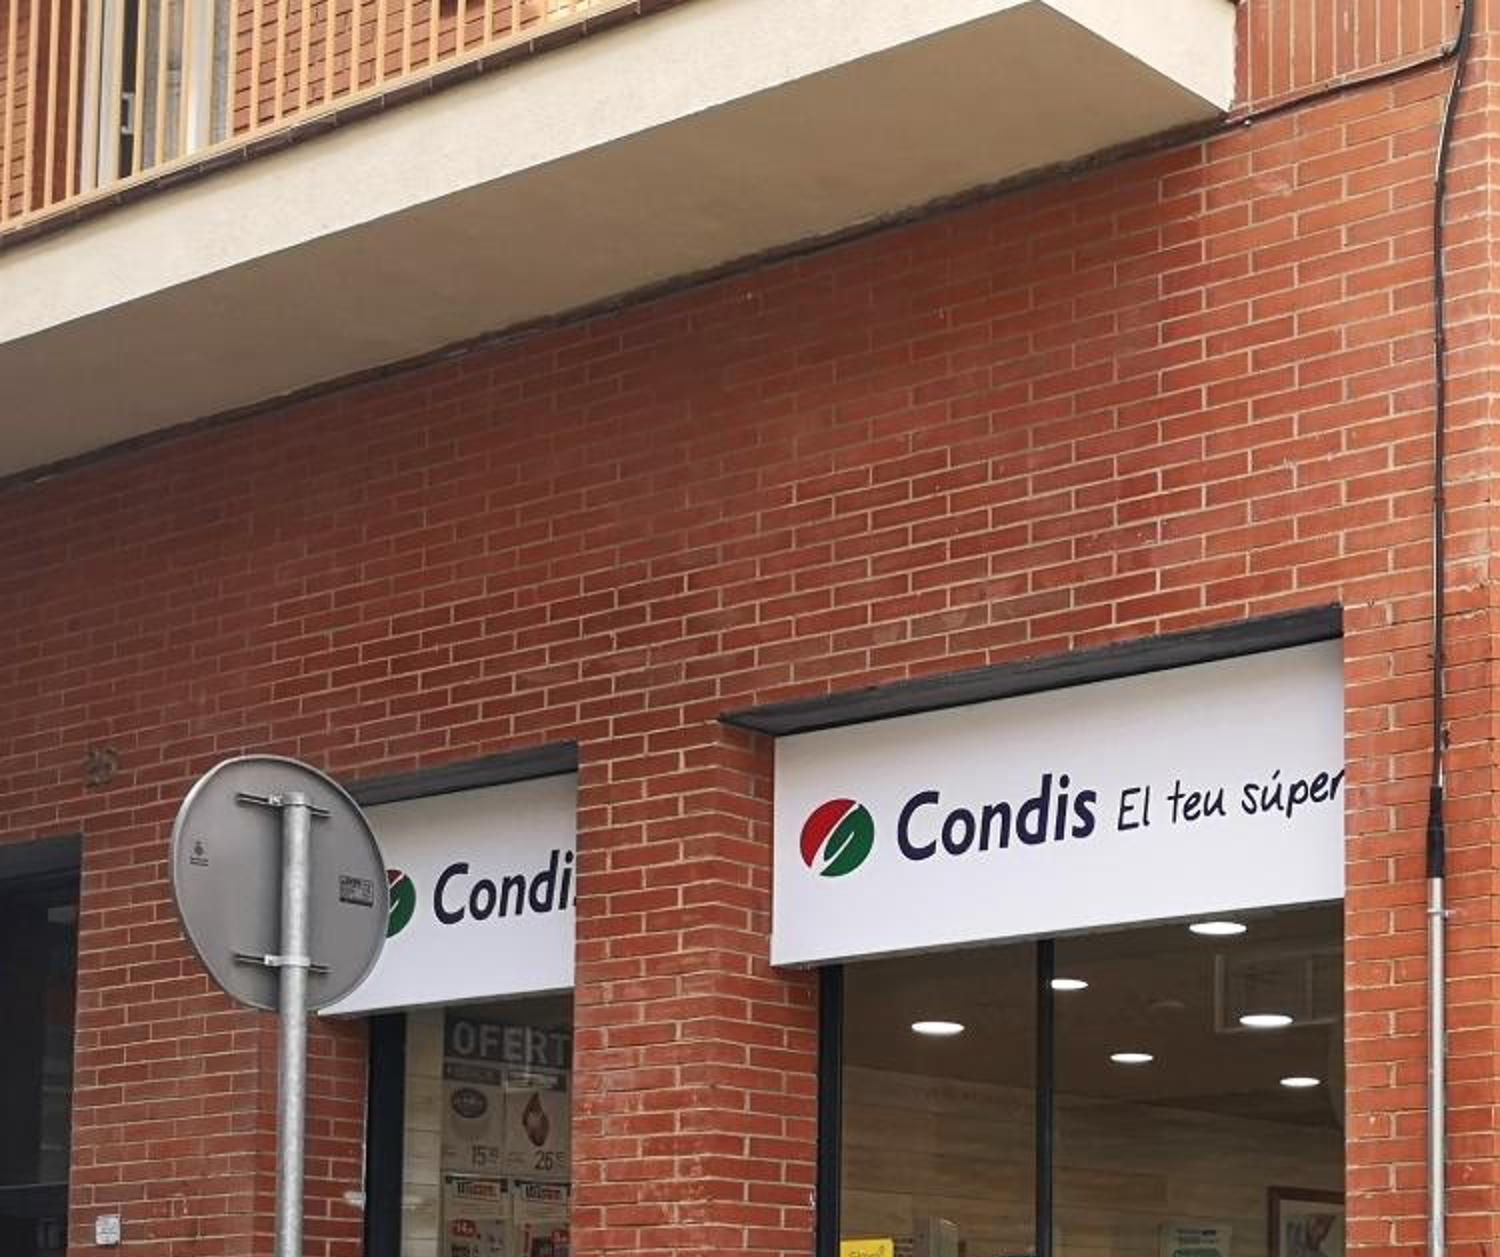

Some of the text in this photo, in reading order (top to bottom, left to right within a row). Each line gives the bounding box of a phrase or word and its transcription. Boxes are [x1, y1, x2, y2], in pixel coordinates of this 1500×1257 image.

[897, 769, 1345, 861] Condis El teu súper
[433, 848, 577, 925] Condi
